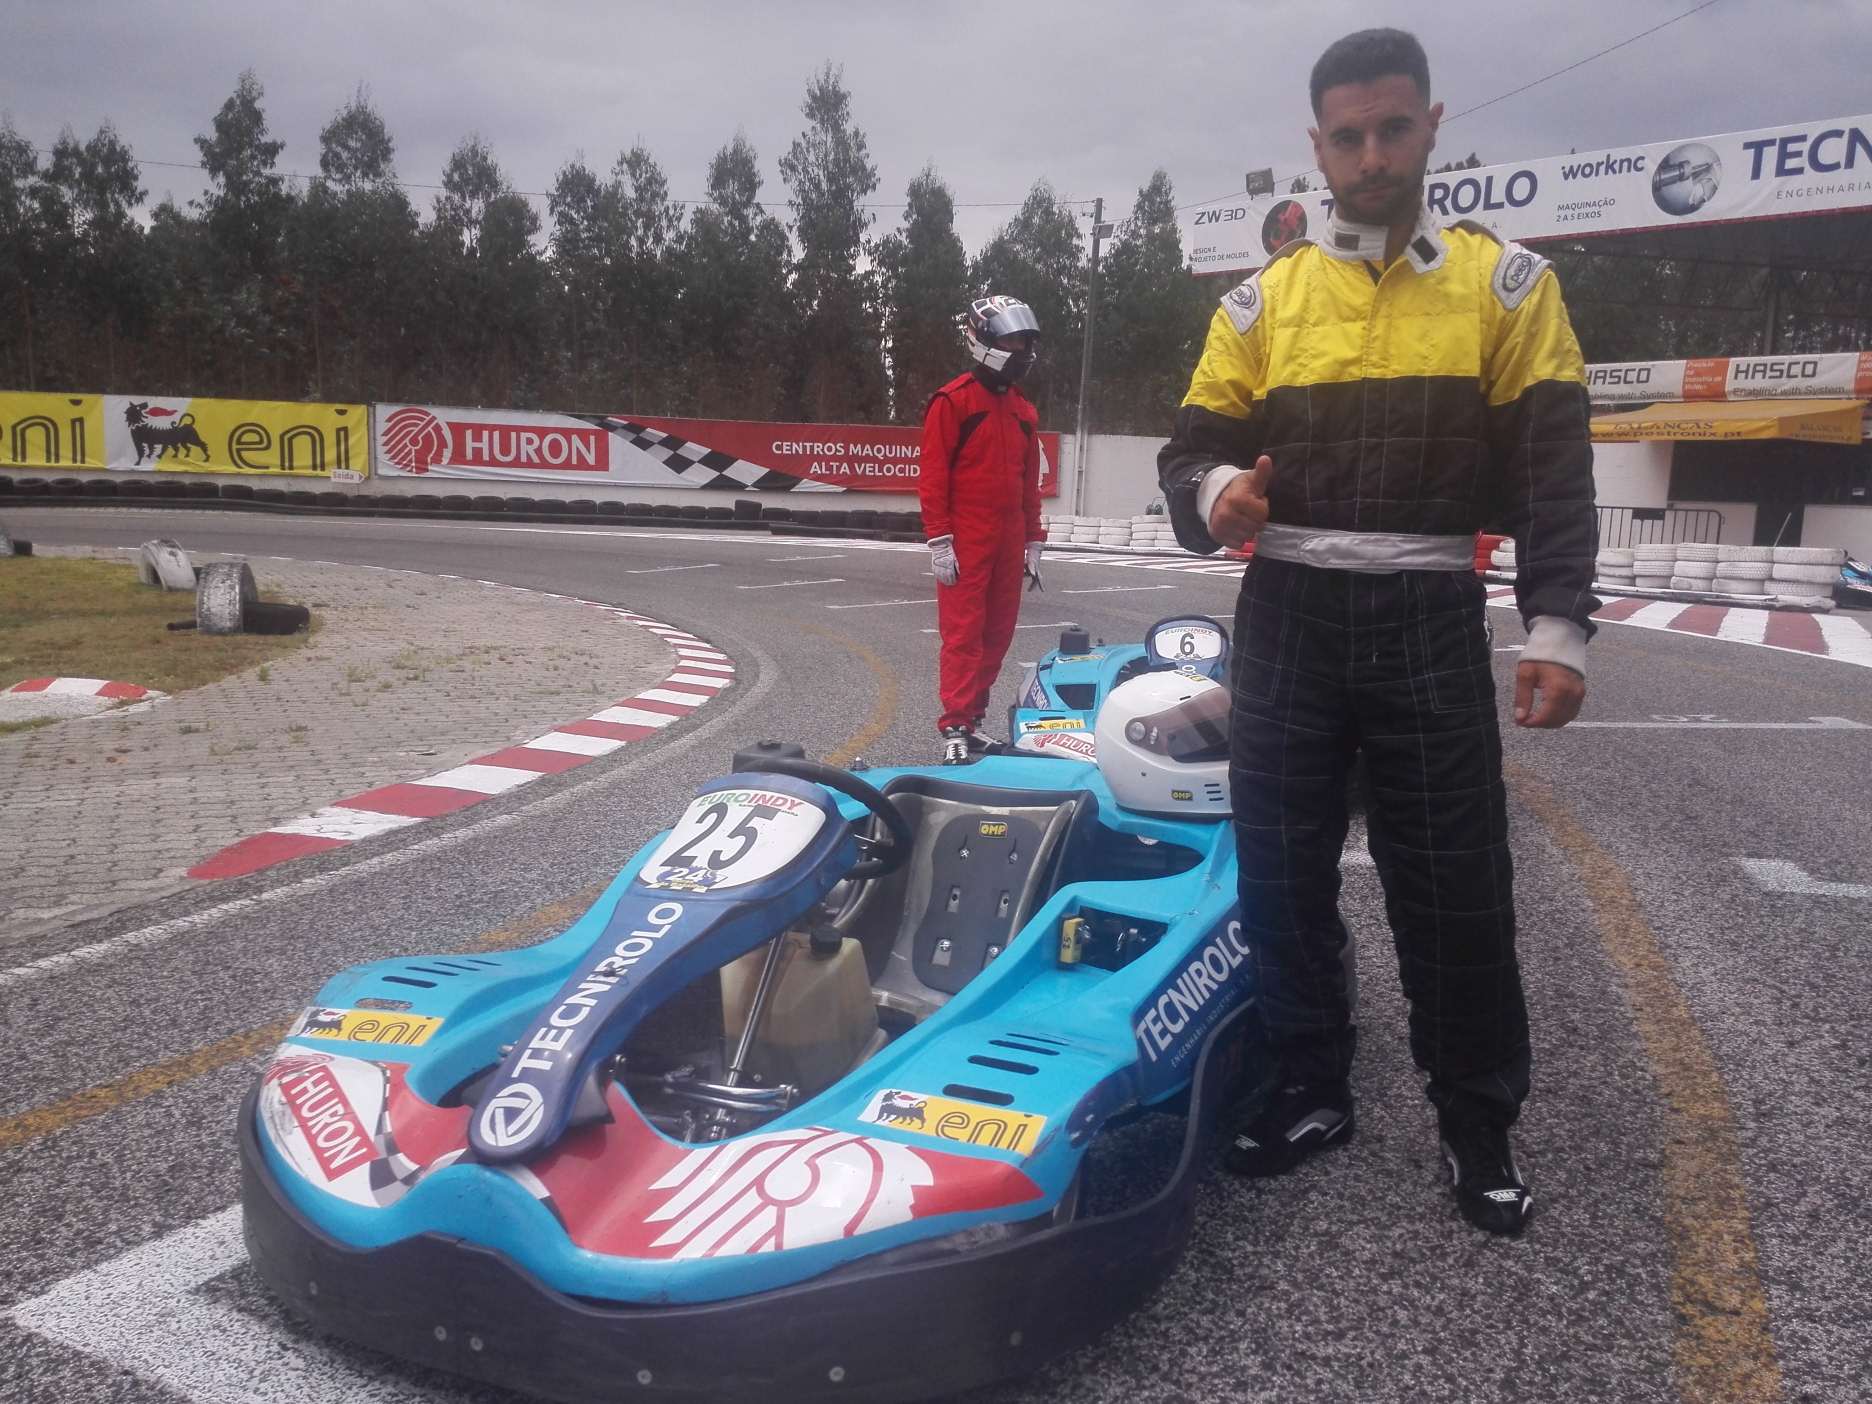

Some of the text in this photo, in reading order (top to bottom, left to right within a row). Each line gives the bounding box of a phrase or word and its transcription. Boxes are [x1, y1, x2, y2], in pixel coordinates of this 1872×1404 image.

[1561, 153, 1646, 181] worknc
[1776, 181, 1872, 200] ENGENHARIA
[1557, 197, 1616, 211] MAQUINAÇÃO
[1577, 210, 1602, 220] EIXOS
[1226, 251, 1249, 260] MOLDES
[1734, 360, 1818, 381] HASCO
[1640, 390, 1674, 401] System
[1782, 385, 1801, 396] with
[1805, 384, 1845, 396] System
[0, 399, 85, 465] ni
[228, 409, 349, 471] eni
[465, 429, 596, 466] HURON
[772, 441, 845, 456] CENTROS
[810, 462, 850, 475] ALTA
[1180, 632, 1195, 656] 6
[697, 792, 804, 811] EUROINDY
[1172, 791, 1192, 800] OMP
[660, 801, 781, 870] 25
[981, 824, 1006, 835] OMP
[511, 902, 684, 1078] TECNIROLO
[349, 1016, 434, 1046] eni
[290, 1070, 368, 1170] HURON
[935, 1111, 1033, 1151] eni
